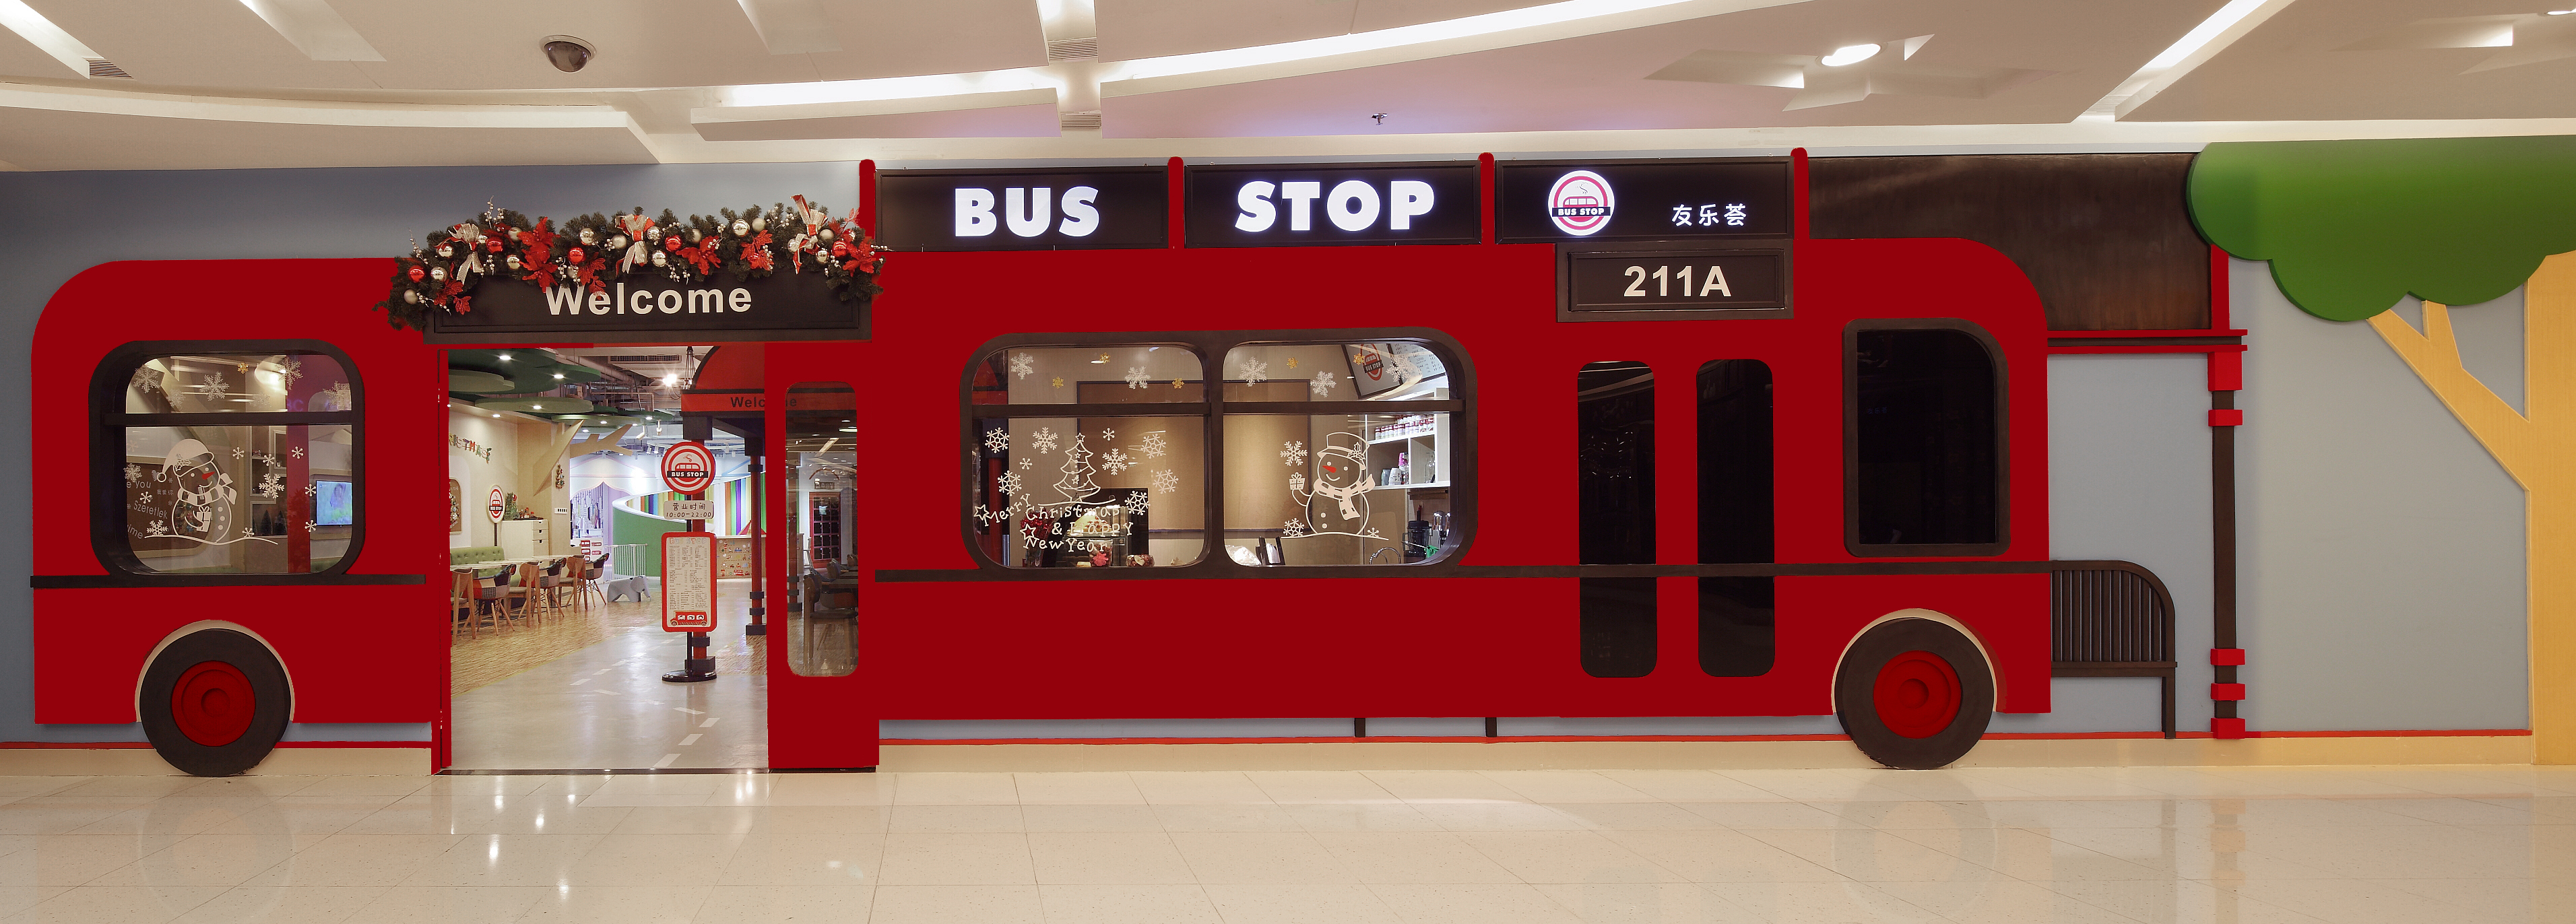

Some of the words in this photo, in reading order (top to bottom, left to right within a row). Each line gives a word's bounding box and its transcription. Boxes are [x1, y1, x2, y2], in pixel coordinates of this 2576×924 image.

[955, 187, 1100, 238] BUS
[1235, 180, 1435, 233] STOP
[1557, 207, 1577, 216] BUS
[1579, 207, 1605, 216] STOP
[1671, 203, 1747, 227] 友乐荟
[1623, 265, 1732, 297] 211A
[545, 282, 752, 315] Welcome
[730, 397, 797, 407] Welce
[133, 500, 167, 519] Szeretlek
[673, 502, 705, 510] 营业时间
[1025, 504, 1120, 521] Christmas
[1051, 522, 1062, 535] &
